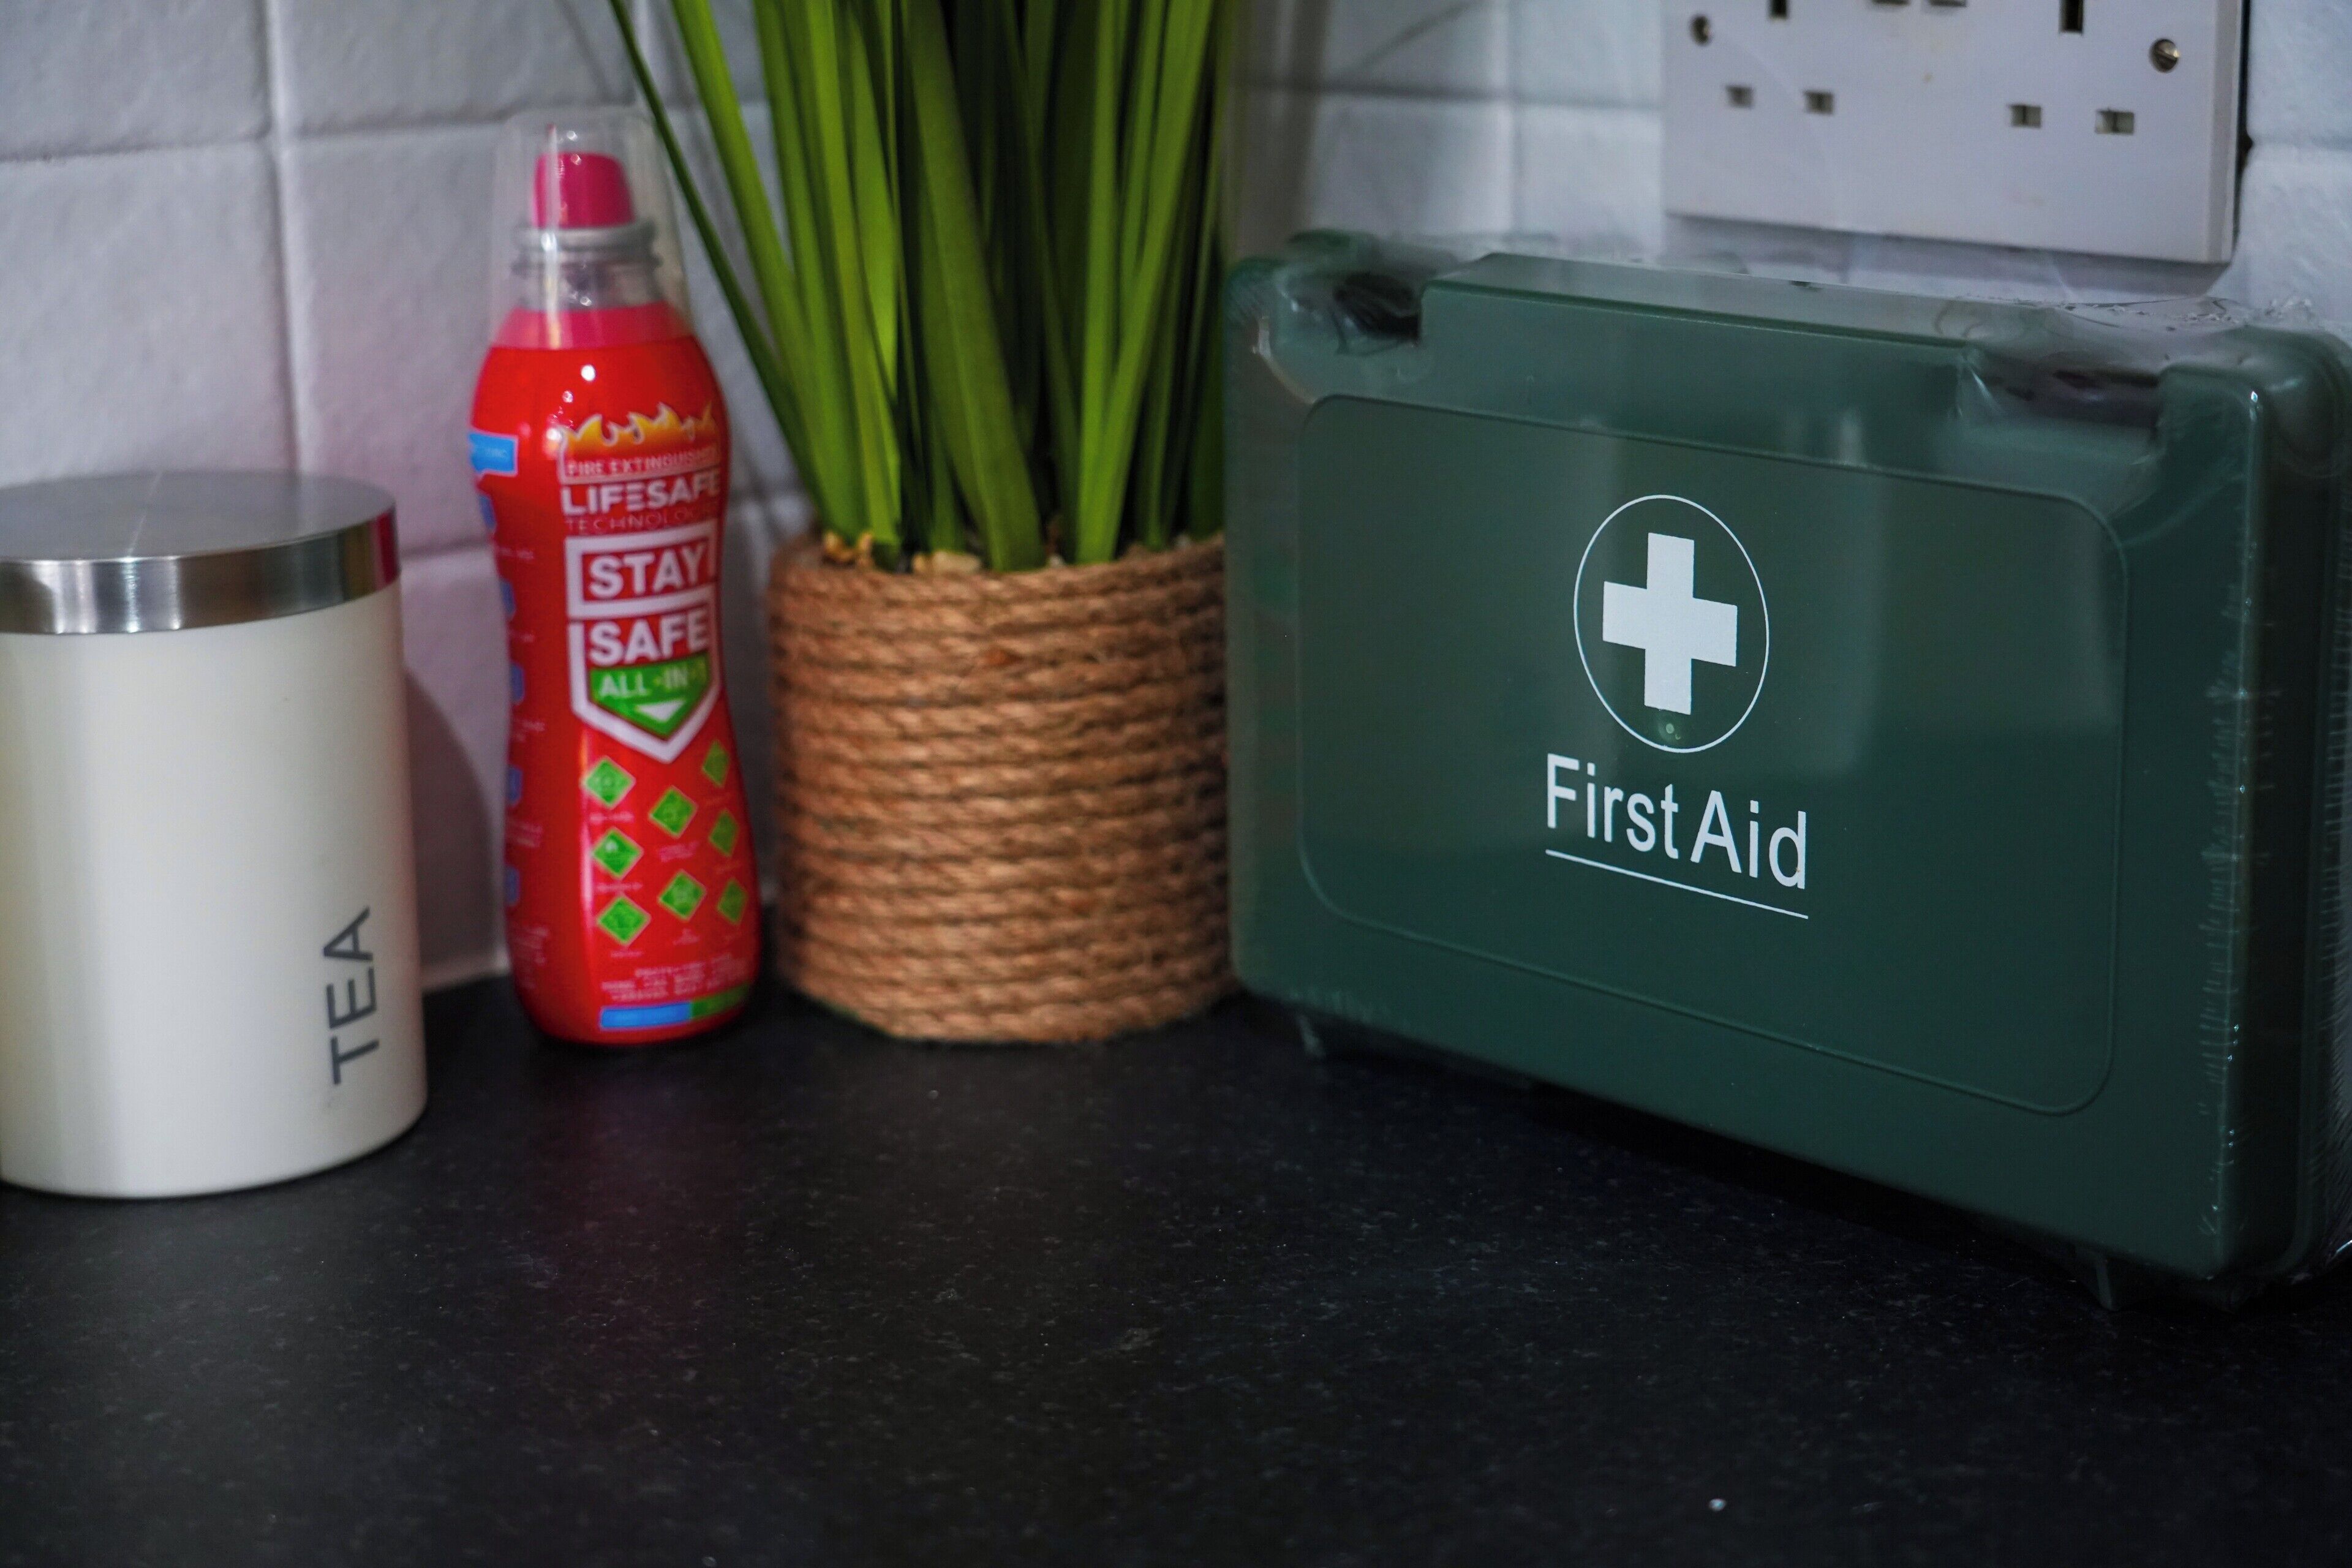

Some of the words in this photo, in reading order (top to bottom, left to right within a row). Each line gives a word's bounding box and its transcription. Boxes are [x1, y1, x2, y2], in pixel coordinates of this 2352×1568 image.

[560, 470, 721, 516] LIFESAFE
[567, 461, 604, 476] FIRE
[589, 544, 704, 599] STAY
[589, 608, 709, 666] SAFE
[1547, 753, 1679, 859] First
[1691, 790, 1807, 889] Aid
[323, 905, 380, 1085] TEA
